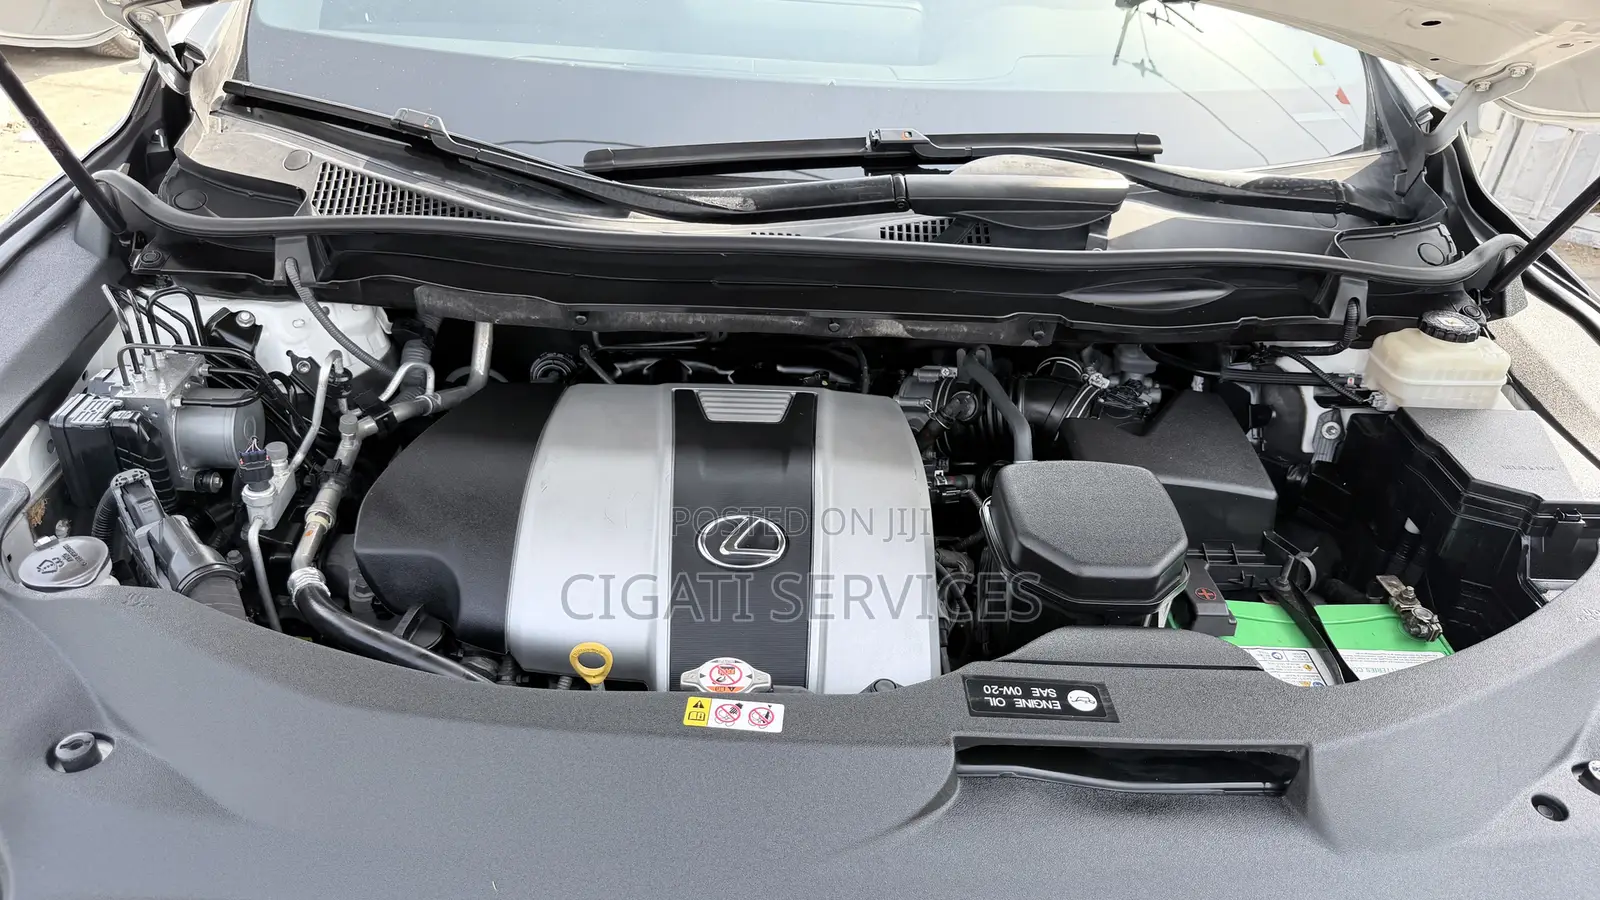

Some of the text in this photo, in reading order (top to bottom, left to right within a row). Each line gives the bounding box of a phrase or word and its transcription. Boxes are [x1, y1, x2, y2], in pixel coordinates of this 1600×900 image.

[983, 684, 1057, 698] SAE 0W-20
[984, 696, 1062, 710] ENGINE OIL
